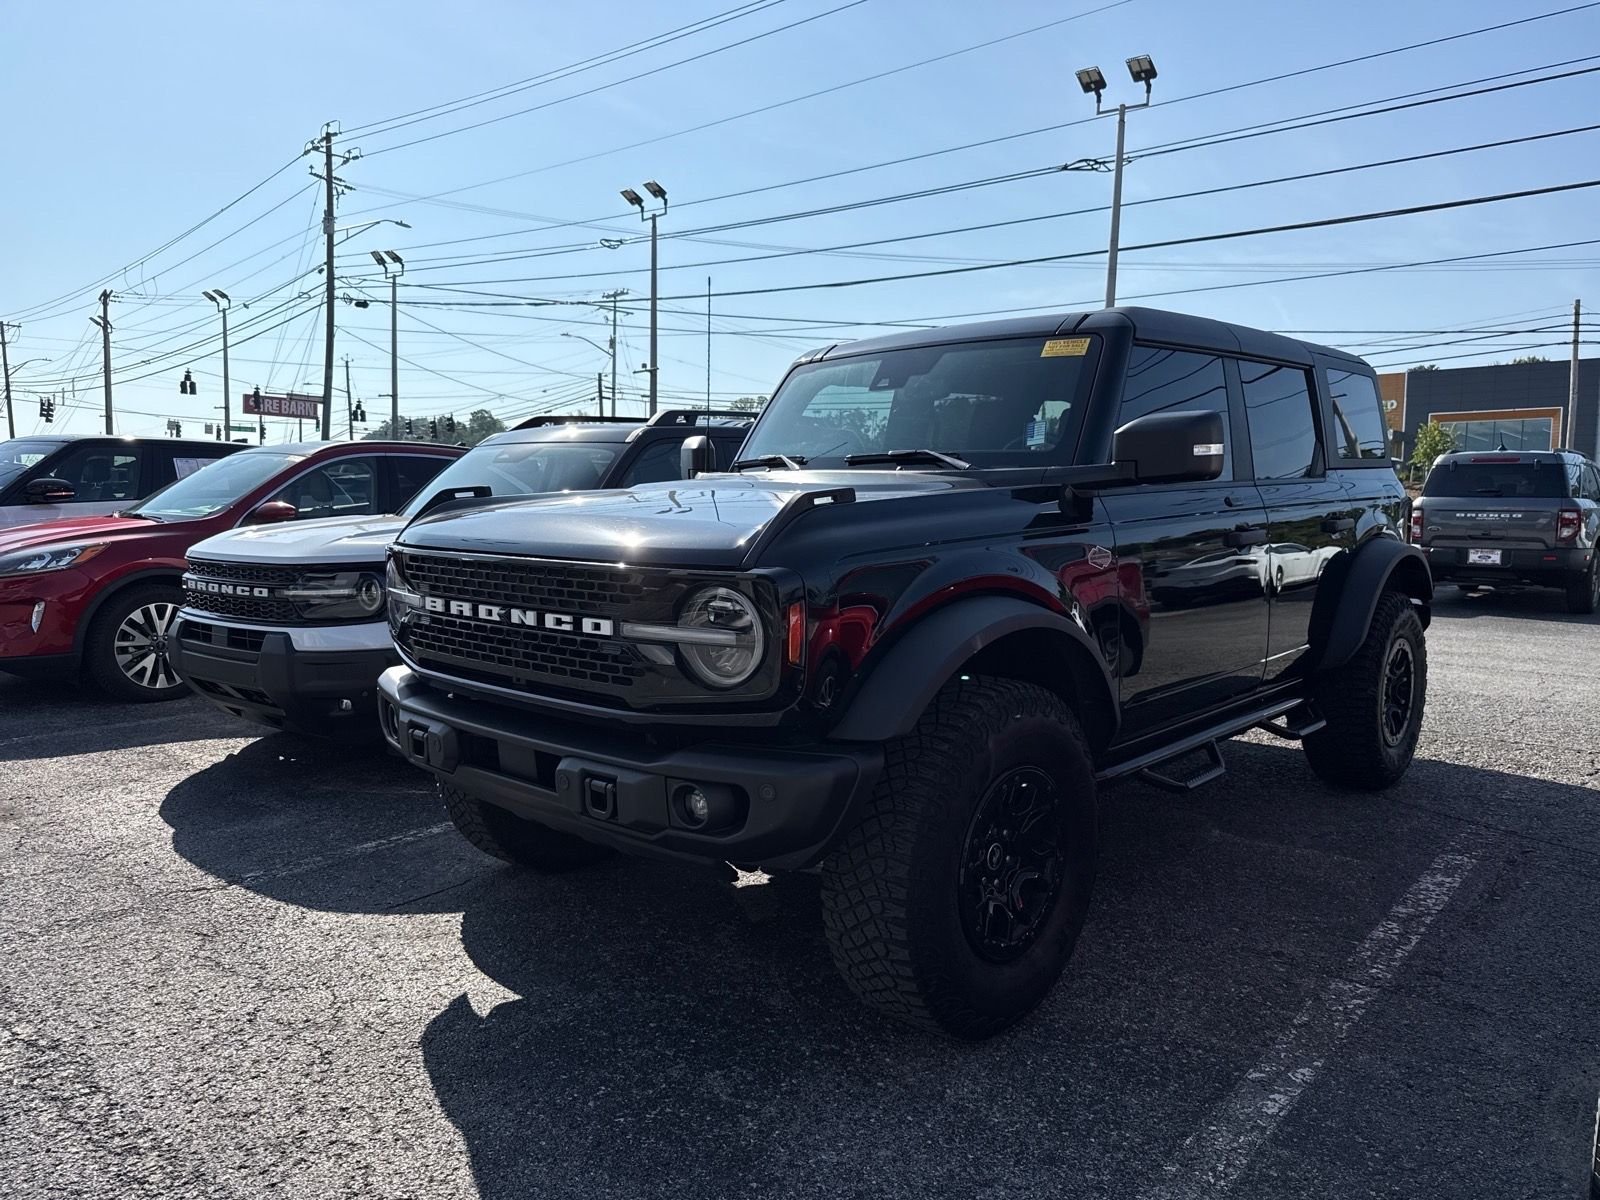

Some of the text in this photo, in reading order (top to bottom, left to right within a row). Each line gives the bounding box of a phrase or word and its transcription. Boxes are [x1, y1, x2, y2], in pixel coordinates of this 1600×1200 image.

[281, 400, 314, 416] BARN
[187, 579, 269, 597] BRONCO
[425, 596, 614, 636] BRONCO
